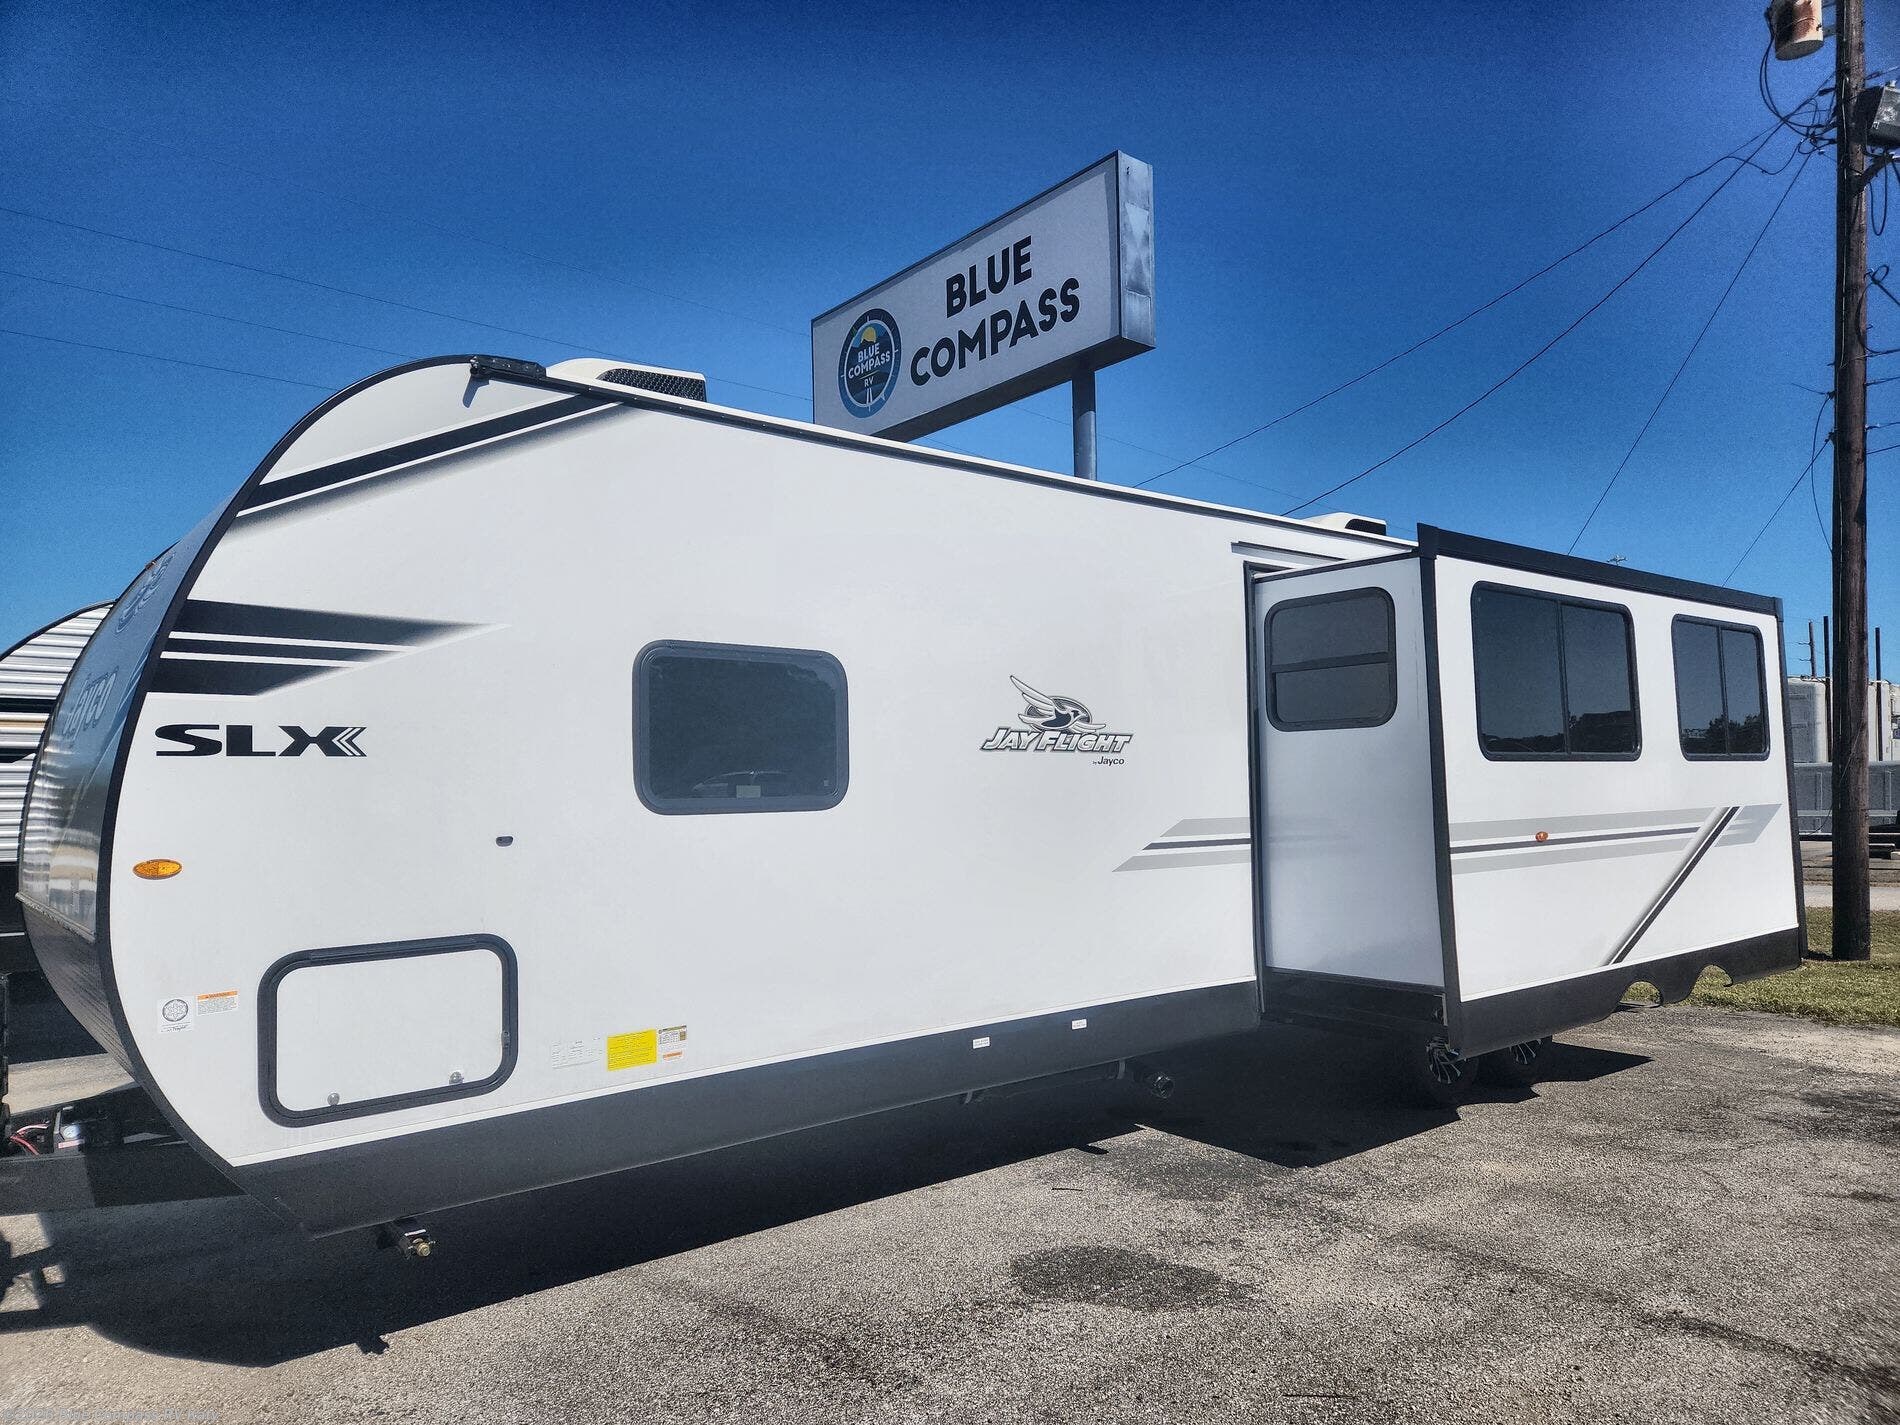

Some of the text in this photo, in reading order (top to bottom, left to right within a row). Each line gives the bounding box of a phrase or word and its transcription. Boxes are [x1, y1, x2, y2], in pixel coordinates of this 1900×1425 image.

[946, 235, 1032, 318] BLUE
[910, 277, 1080, 386] COMPASS
[847, 350, 891, 379] COMPASS
[857, 342, 880, 363] BLUE
[864, 376, 874, 387] RV
[155, 724, 367, 757] SLX
[980, 727, 1133, 753] JAY FLIGHT
[1097, 756, 1125, 767] Jayco
